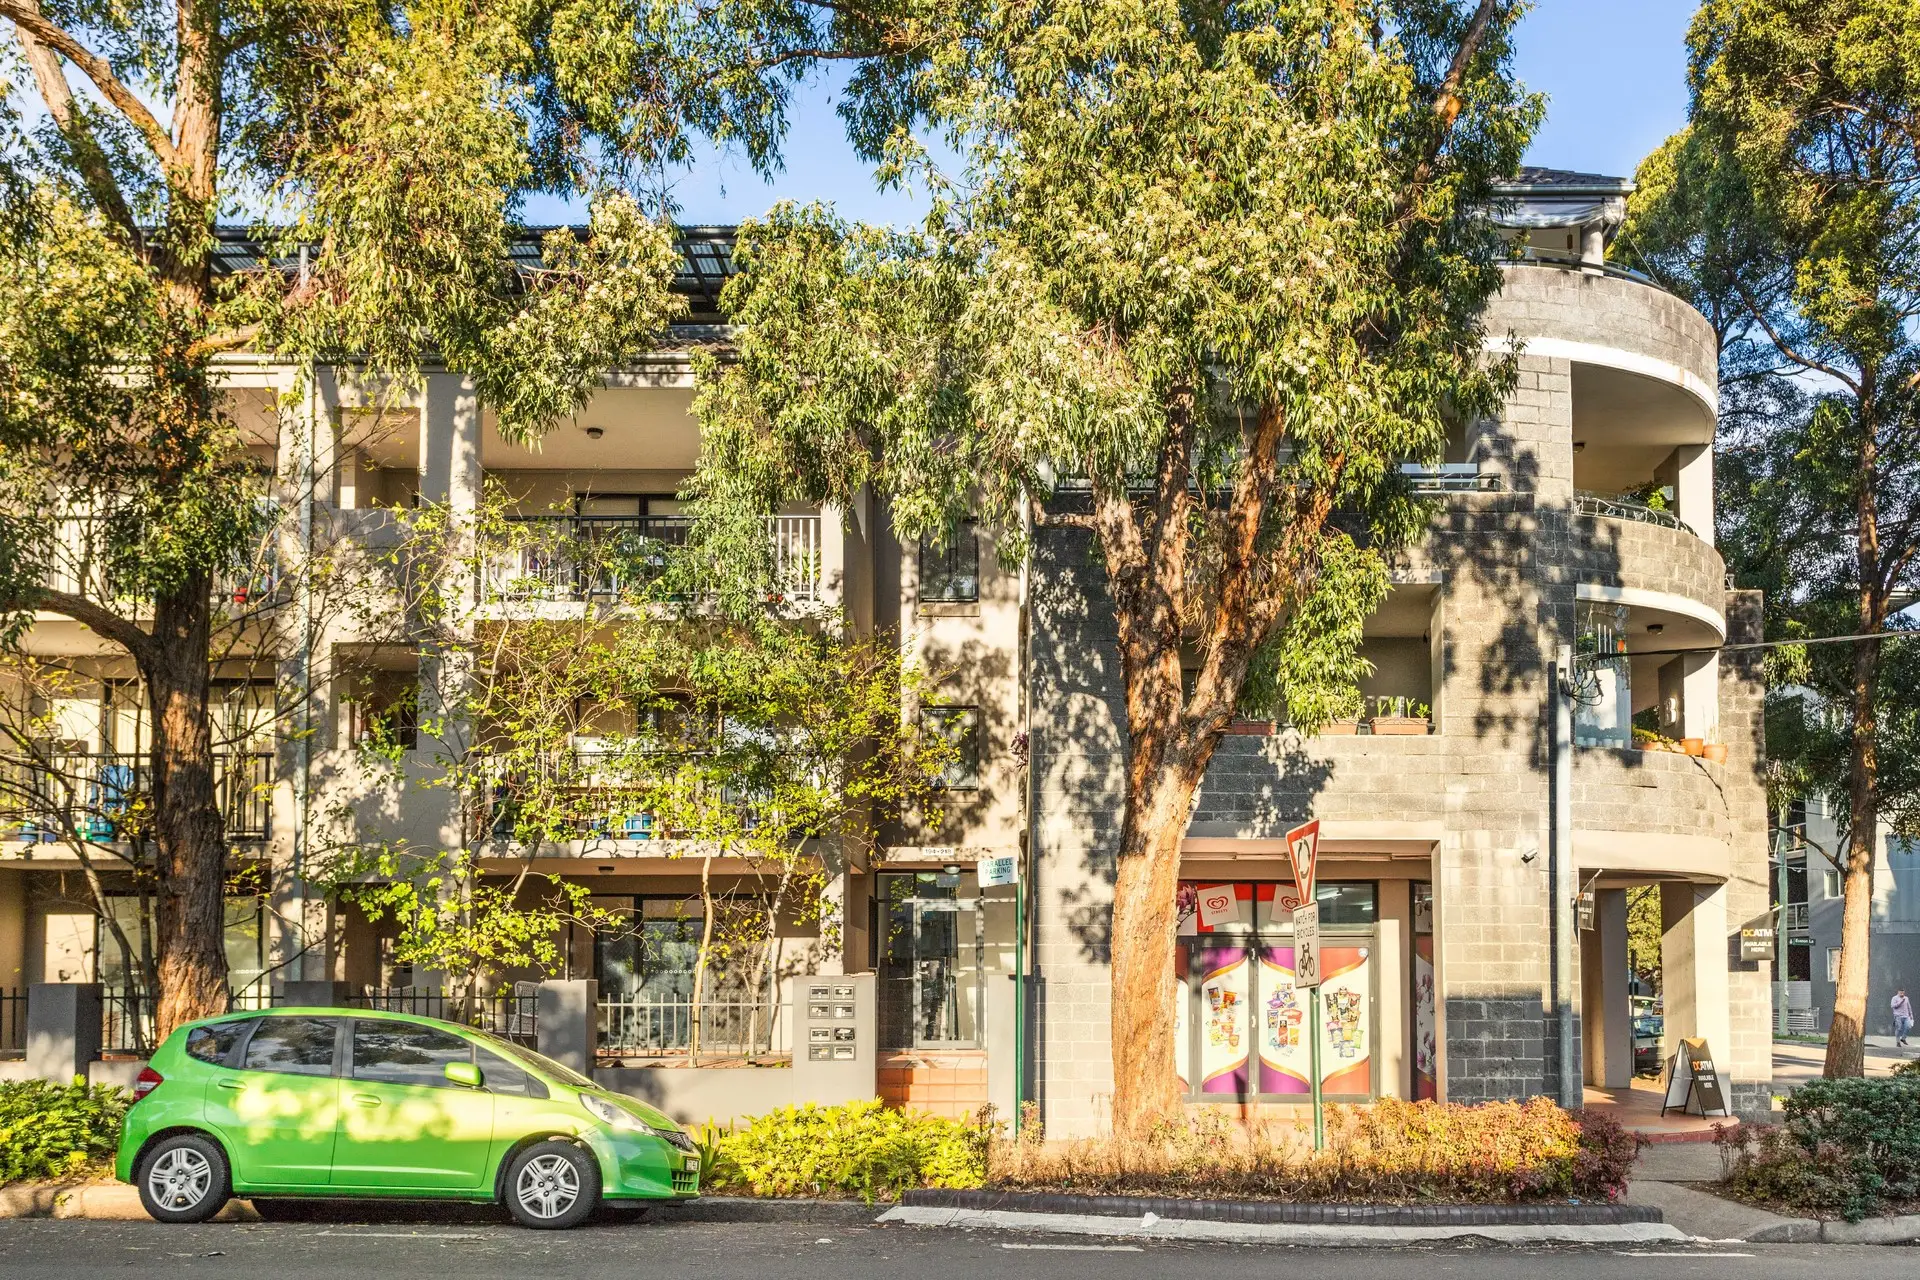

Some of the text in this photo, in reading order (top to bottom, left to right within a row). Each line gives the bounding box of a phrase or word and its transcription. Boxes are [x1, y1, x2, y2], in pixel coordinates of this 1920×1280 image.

[982, 858, 1013, 867] PARALLEL
[985, 866, 1011, 875] PARKING
[1742, 928, 1772, 936] DCATM
